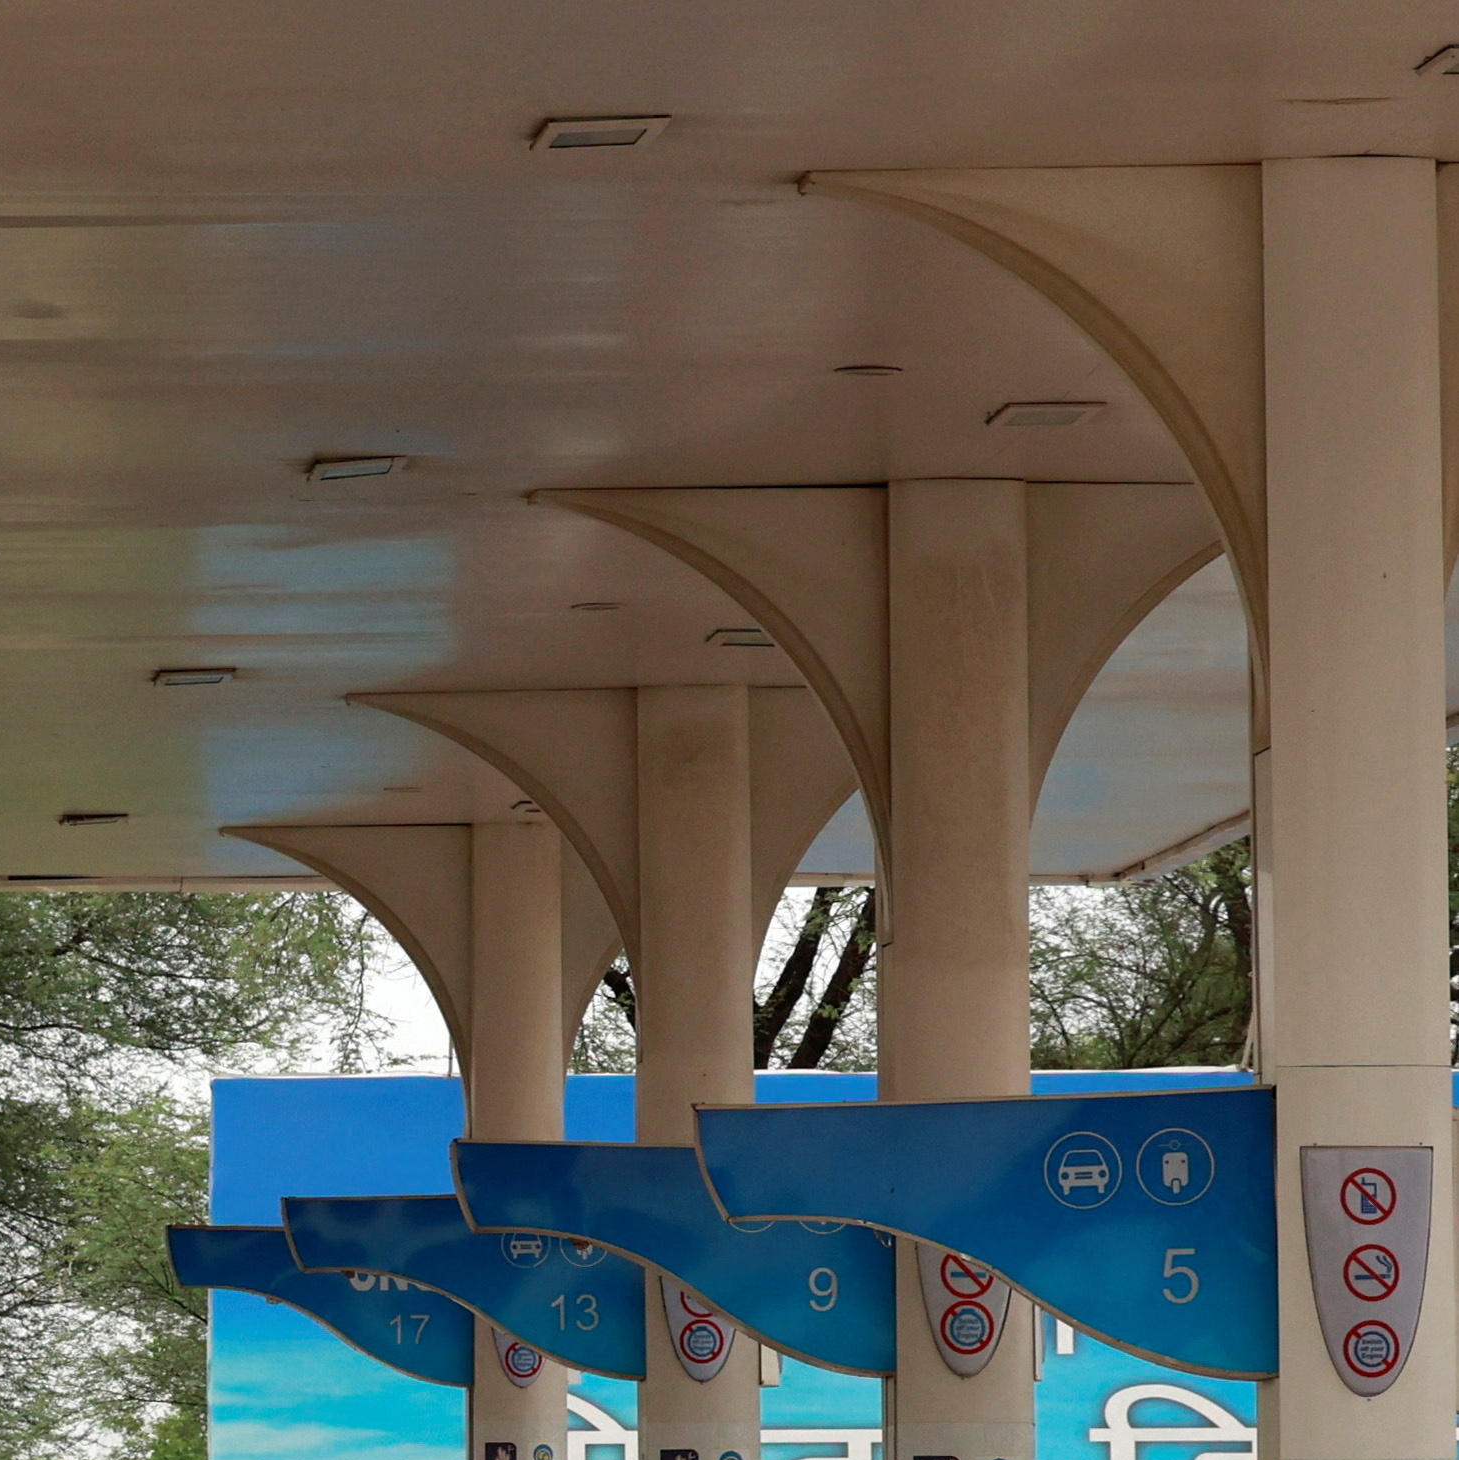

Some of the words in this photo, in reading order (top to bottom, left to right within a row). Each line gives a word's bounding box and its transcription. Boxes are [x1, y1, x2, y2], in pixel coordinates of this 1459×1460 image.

[807, 1267, 839, 1314] 9
[1162, 1248, 1200, 1304] 5
[389, 1314, 430, 1345] 17
[550, 1294, 601, 1331] 13
